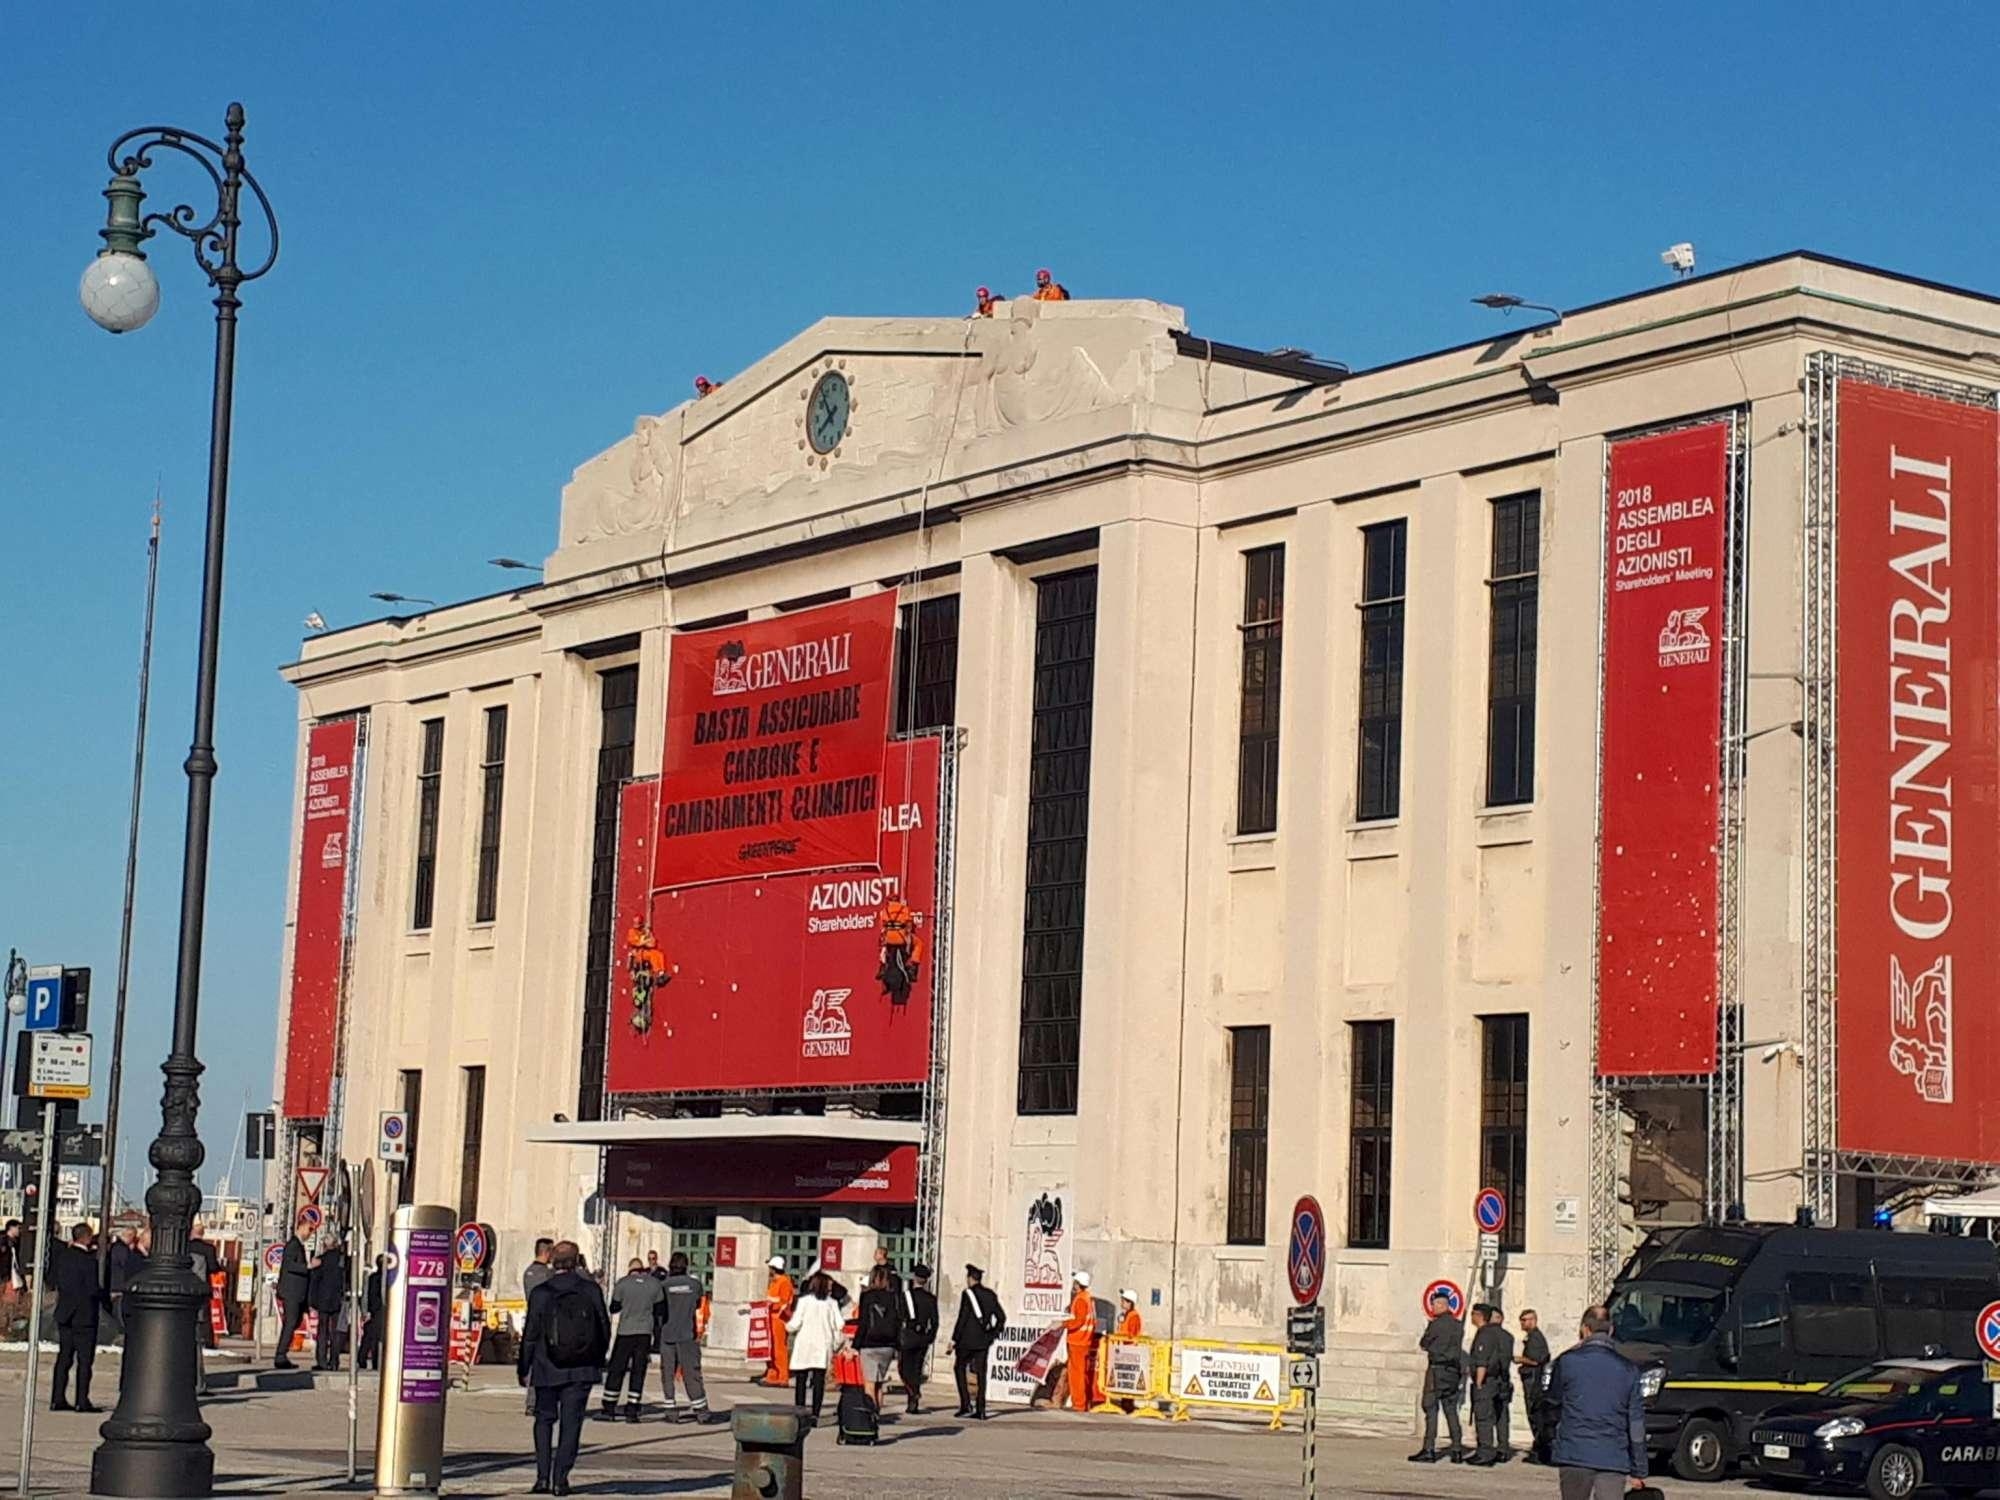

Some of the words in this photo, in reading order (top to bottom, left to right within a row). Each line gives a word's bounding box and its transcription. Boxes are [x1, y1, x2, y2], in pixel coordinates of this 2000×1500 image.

[1617, 485, 1652, 509] 2018
[1617, 497, 1715, 531] ASSEMBLEA
[1616, 529, 1661, 555] DEGLI
[1616, 547, 1692, 578] AZIONISTI
[1675, 566, 1714, 582] Meeting
[746, 632, 852, 690] GENERALI
[1659, 648, 1710, 668] GENERALI
[1889, 444, 1952, 940] GENERALI
[693, 706, 750, 746] BASTA
[756, 683, 862, 737] ASSICURARE
[723, 740, 802, 786] CARBONE
[809, 737, 821, 774] E
[664, 788, 783, 839] CAMBIAMENTI
[790, 774, 878, 822] CLIMATICI
[809, 876, 898, 912] AZIONISTI
[808, 911, 877, 934] Shareholders'
[35, 987, 50, 1021] P
[802, 1039, 850, 1058] GENERALI
[417, 1260, 444, 1277] 778
[1200, 1369, 1260, 1382] CAMBIAMENTI
[1208, 1379, 1251, 1391] CLIMATICI
[1220, 1389, 1249, 1400] CORSO
